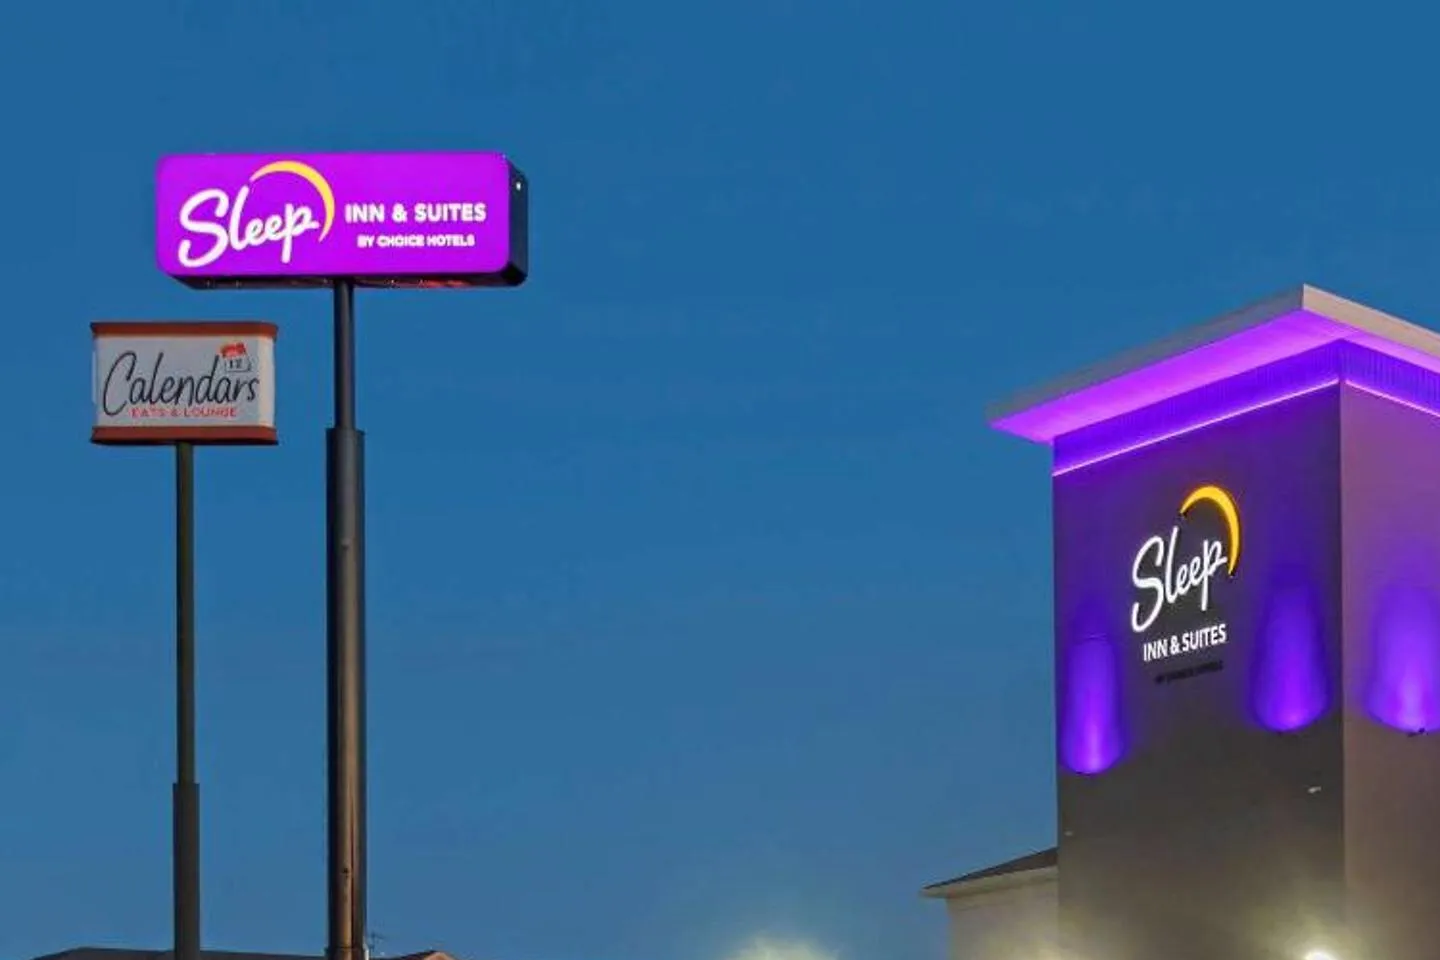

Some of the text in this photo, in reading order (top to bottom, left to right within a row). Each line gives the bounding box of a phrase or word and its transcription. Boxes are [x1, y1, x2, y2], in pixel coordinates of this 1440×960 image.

[178, 185, 320, 268] Sleep
[345, 203, 487, 223] INN & SUITES
[357, 234, 475, 247] BY CHOICE HOTELS
[103, 350, 260, 416] Calendars
[1131, 525, 1228, 632] Sleep
[1143, 623, 1227, 662] INN & SUITES
